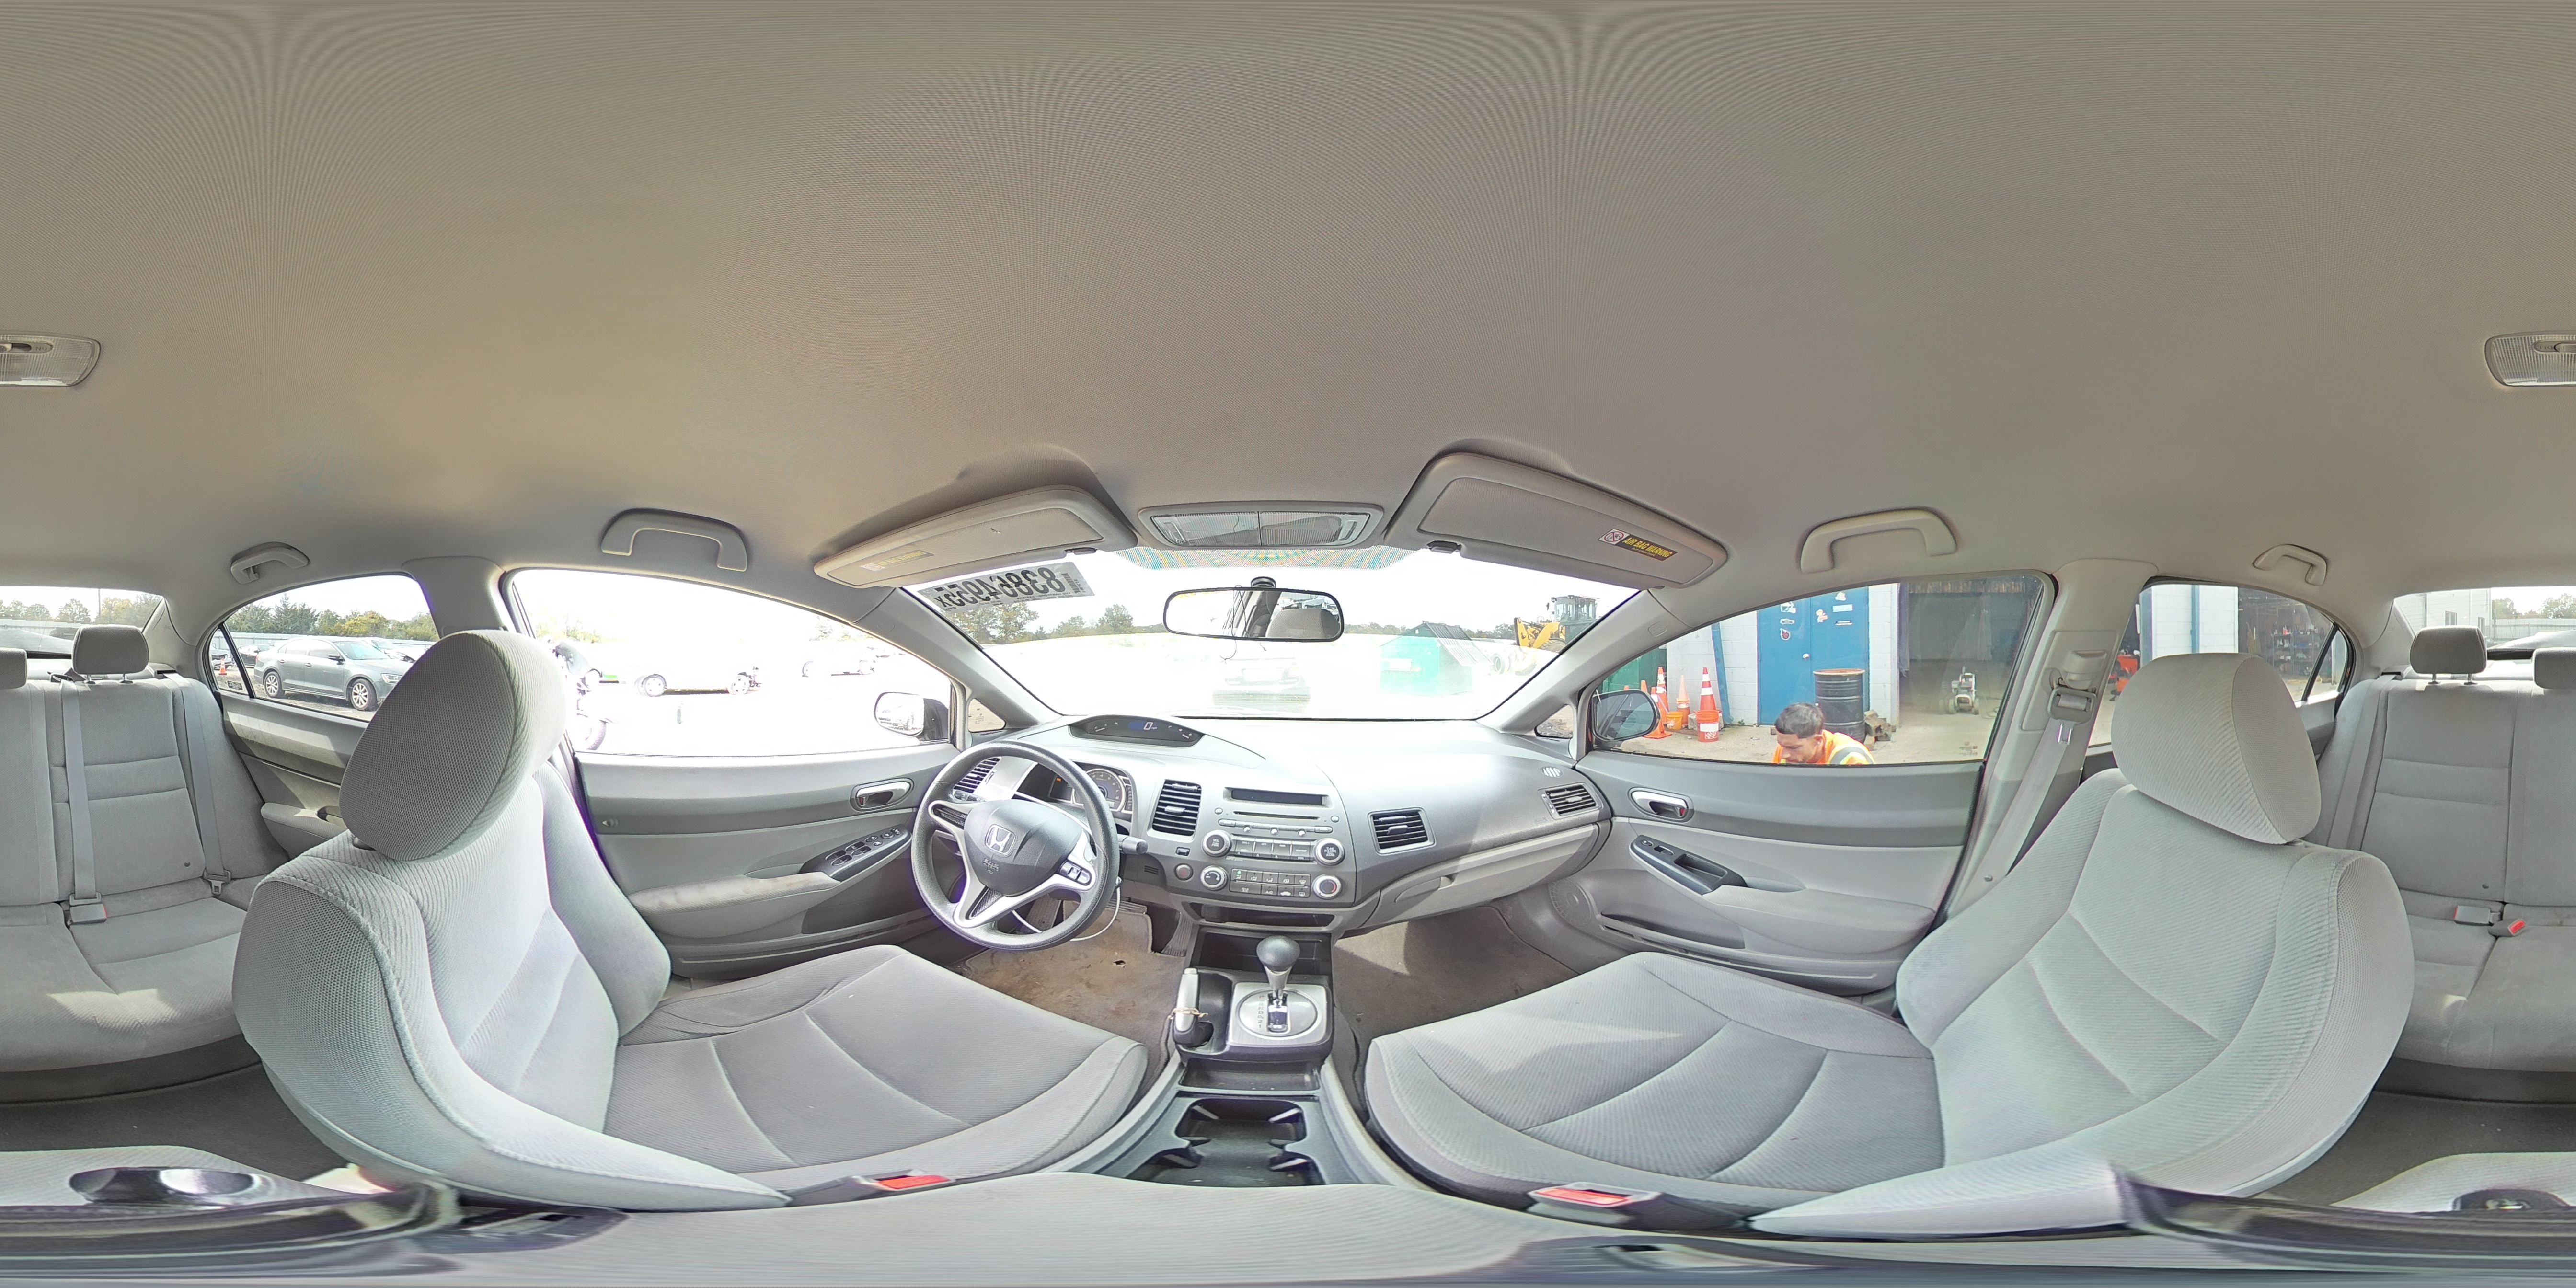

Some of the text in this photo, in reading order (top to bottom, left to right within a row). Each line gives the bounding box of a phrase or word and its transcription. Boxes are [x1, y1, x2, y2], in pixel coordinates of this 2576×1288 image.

[1622, 537, 1673, 557] AIR BAG WARNING
[1143, 722, 1153, 730] 0
